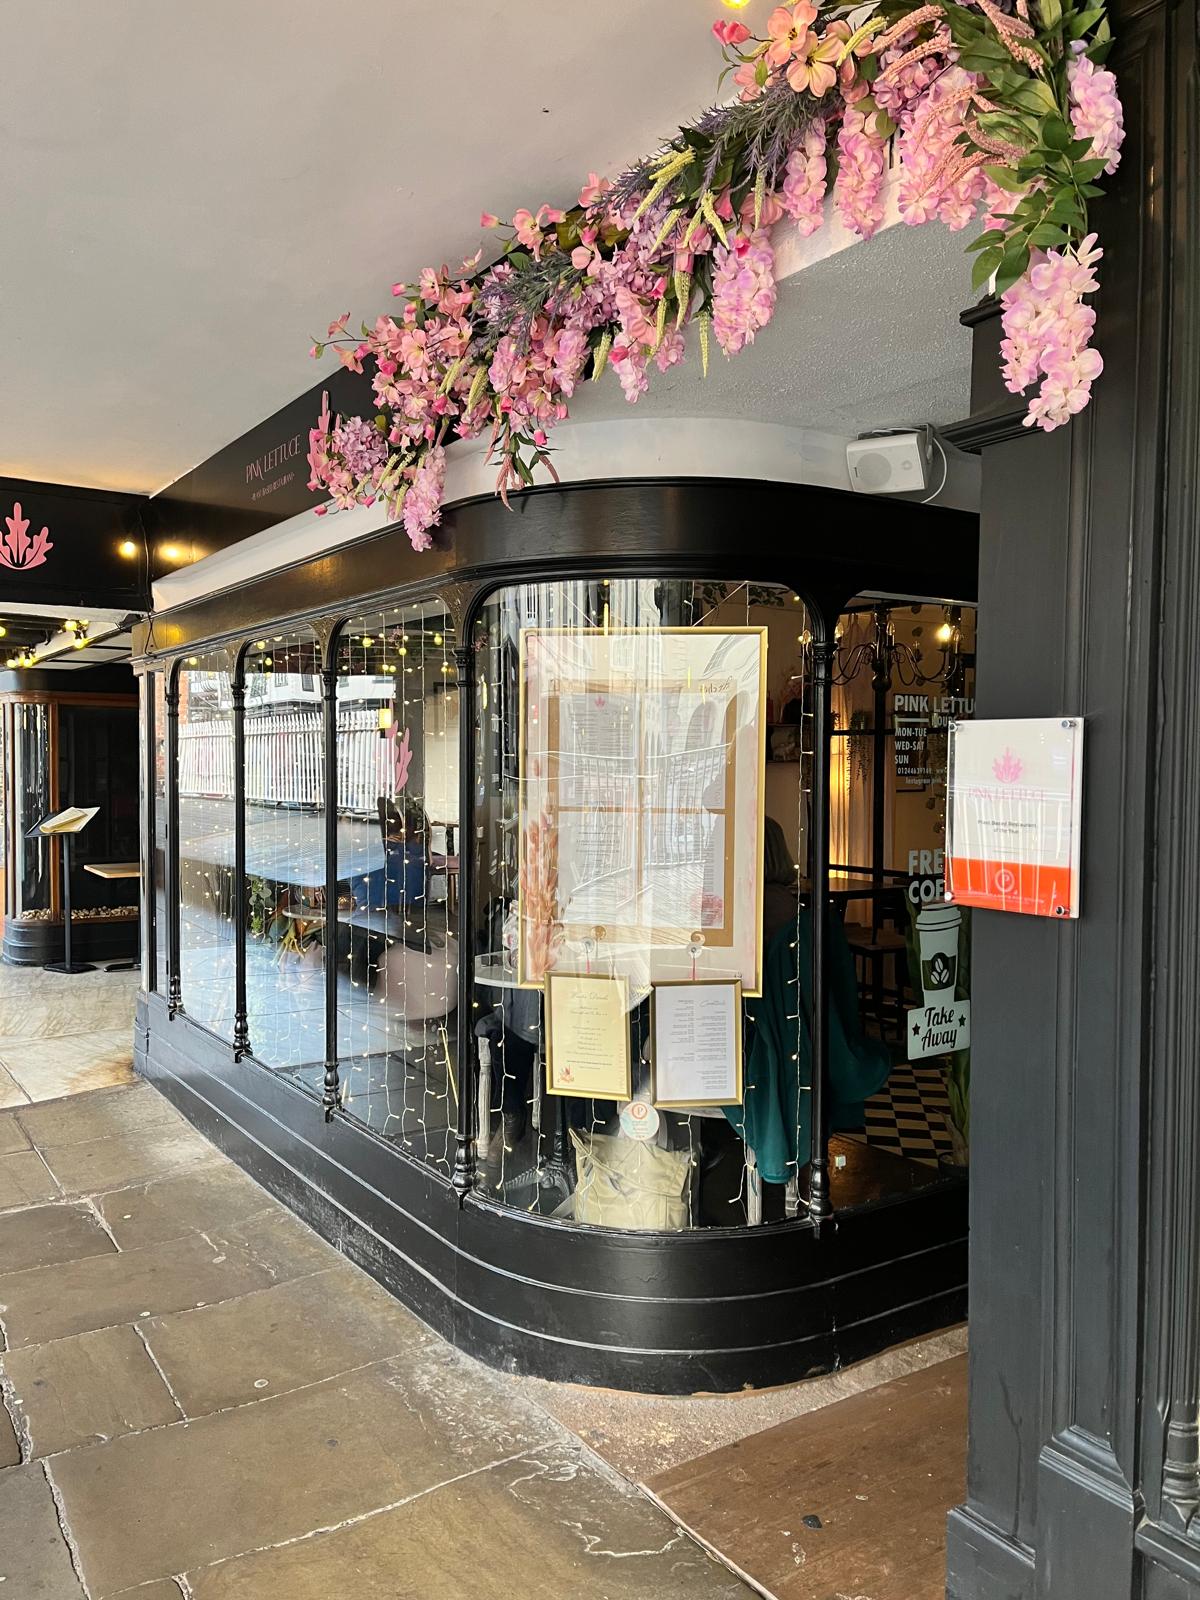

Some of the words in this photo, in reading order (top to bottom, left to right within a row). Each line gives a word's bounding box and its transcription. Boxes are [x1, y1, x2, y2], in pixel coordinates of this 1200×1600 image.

[246, 458, 264, 484] PINK
[264, 434, 301, 473] LETTUCE
[894, 694, 929, 713] PINK
[933, 696, 977, 714] LETTU
[894, 727, 928, 737] MON-TUE
[894, 740, 925, 751] WED-SAT
[894, 754, 909, 765] SUN
[924, 1006, 955, 1028] Take
[921, 1027, 958, 1052] Away
